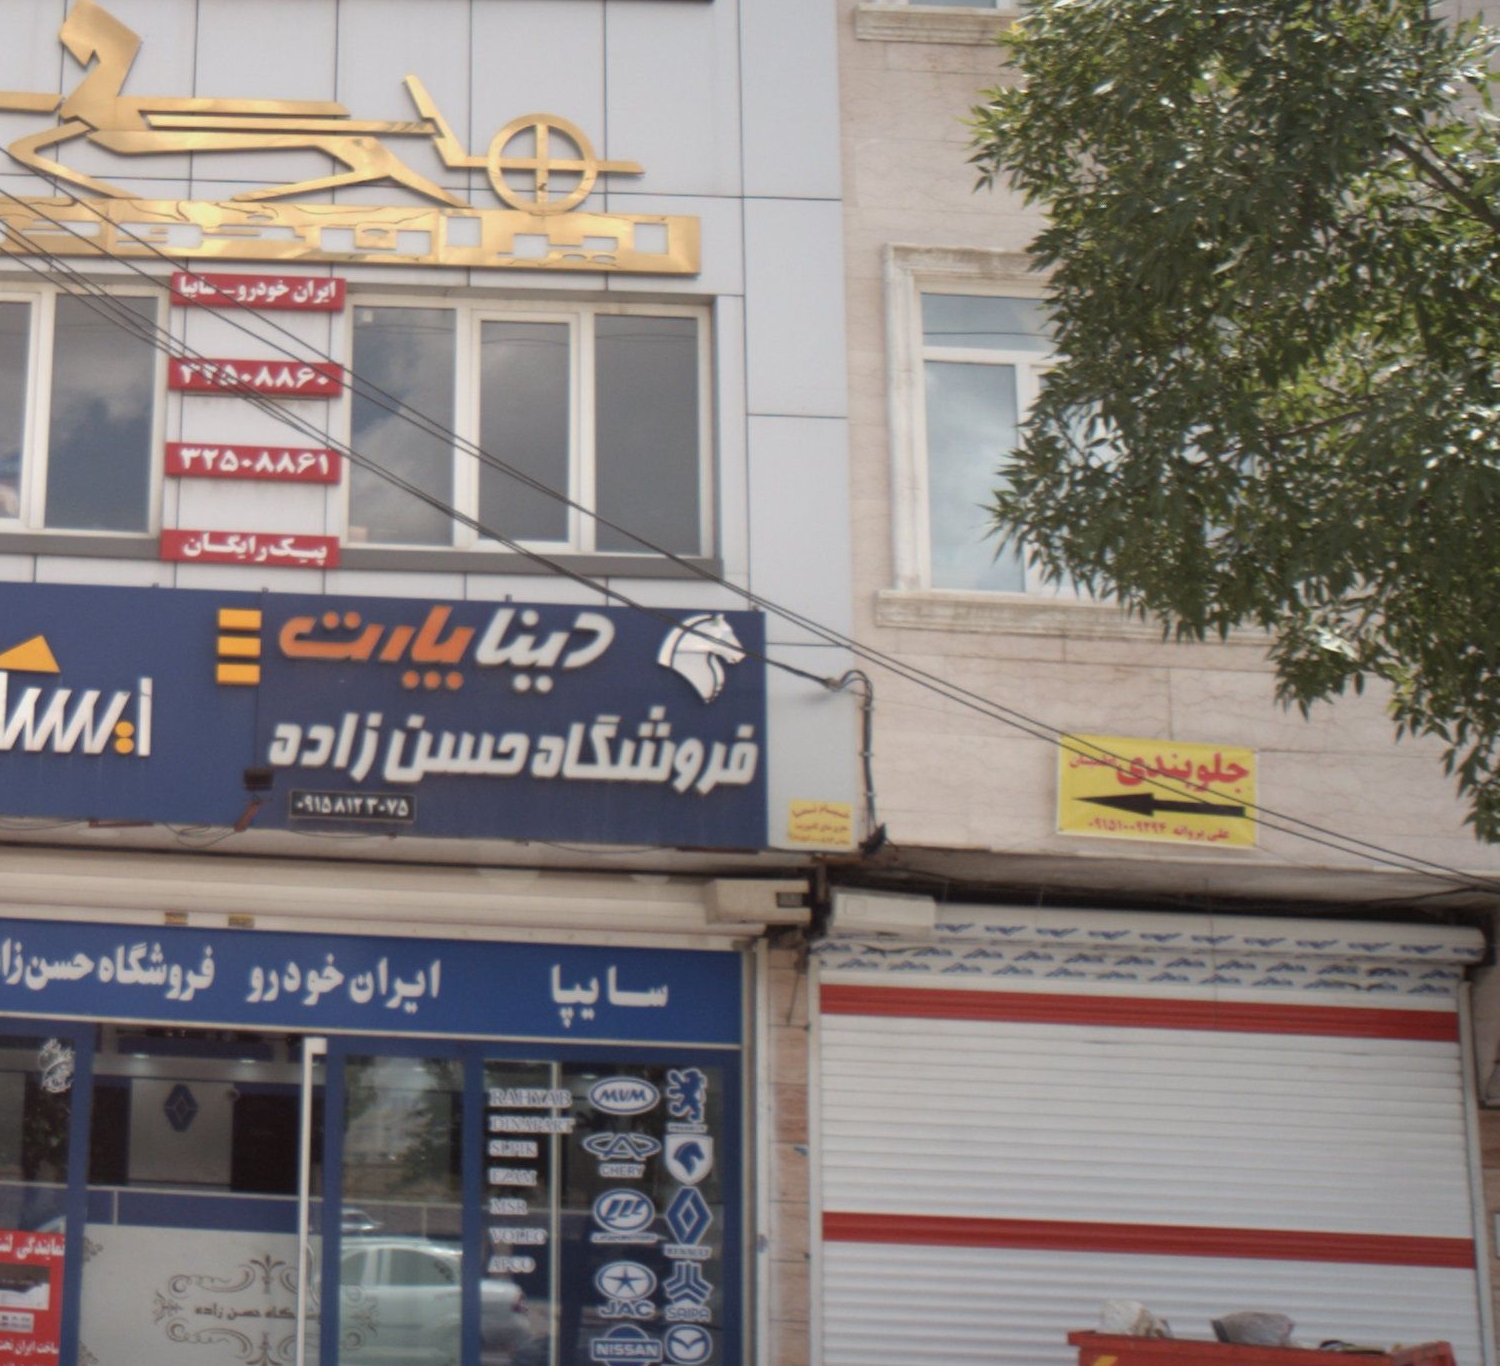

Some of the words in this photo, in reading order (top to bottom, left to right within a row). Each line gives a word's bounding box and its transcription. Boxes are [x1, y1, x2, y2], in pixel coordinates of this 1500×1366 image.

[236, 279, 290, 303] خودرو
[293, 278, 337, 304] ایران
[180, 446, 329, 475] ۳۲۵۰۸۸۶۱
[183, 532, 267, 562] رایگان
[269, 536, 328, 566] پیک
[278, 605, 476, 691] پارت
[474, 608, 617, 694] دینا
[267, 712, 384, 782] زاده
[382, 713, 530, 784] حسن
[532, 704, 760, 795] فروشگاه
[1115, 751, 1250, 794] جلوبندی
[25, 949, 96, 991] حسن
[98, 942, 216, 1001] فروشگاه
[245, 953, 345, 1006] خودرو
[349, 957, 441, 1013] ایران
[551, 962, 669, 1028] سایپا
[599, 1089, 648, 1103] MVM
[601, 1163, 645, 1178] CHERY
[601, 1301, 656, 1318] JAC
[666, 1306, 710, 1320] SAIPA
[595, 1343, 659, 1358] NISSAN
